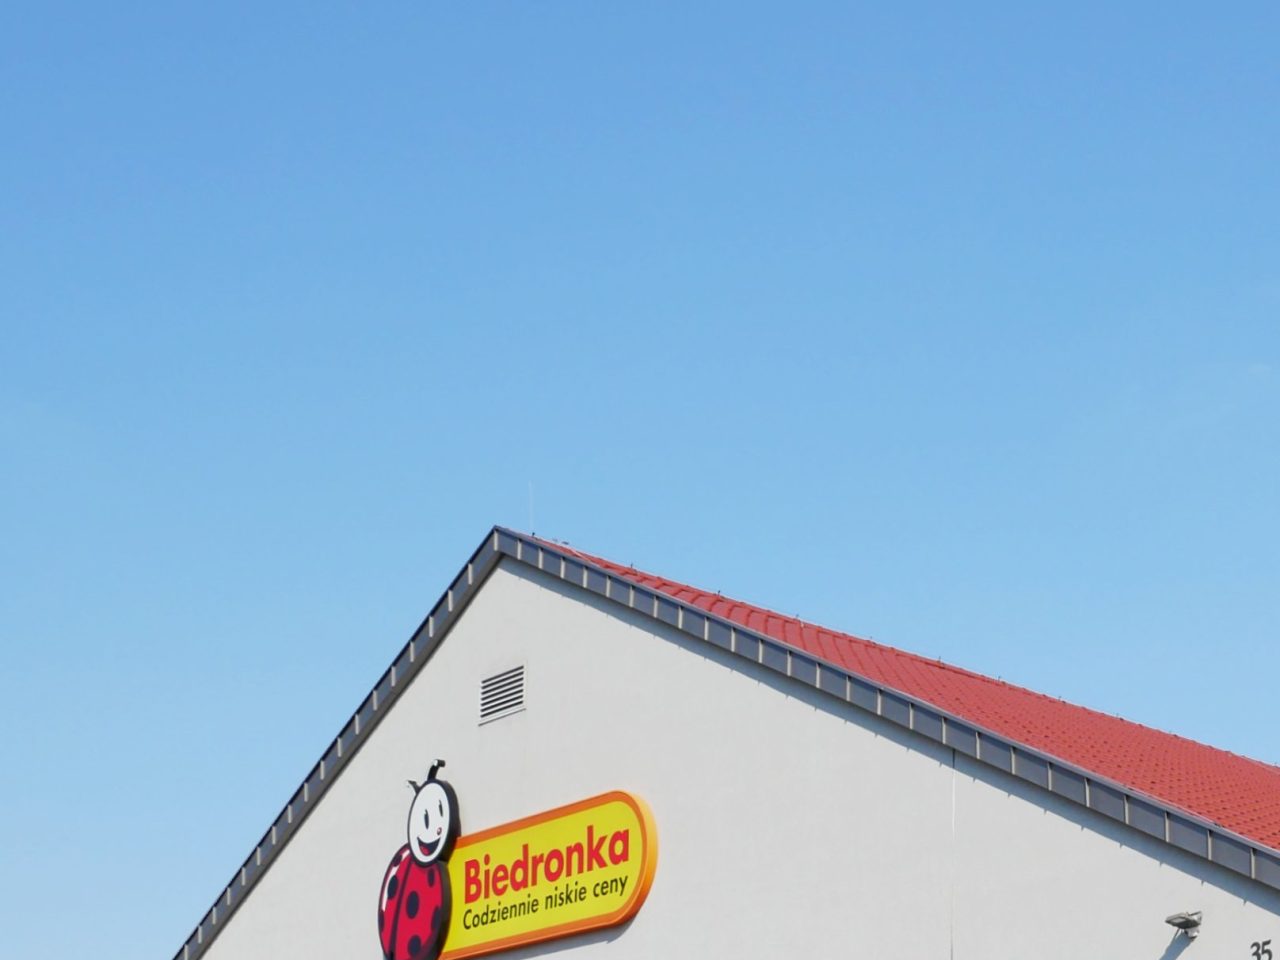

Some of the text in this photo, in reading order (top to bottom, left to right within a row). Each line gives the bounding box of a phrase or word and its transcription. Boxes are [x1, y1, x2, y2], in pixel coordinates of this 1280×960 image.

[462, 824, 631, 904] Biedronka
[463, 873, 629, 930] Codziennie niskie ceny
